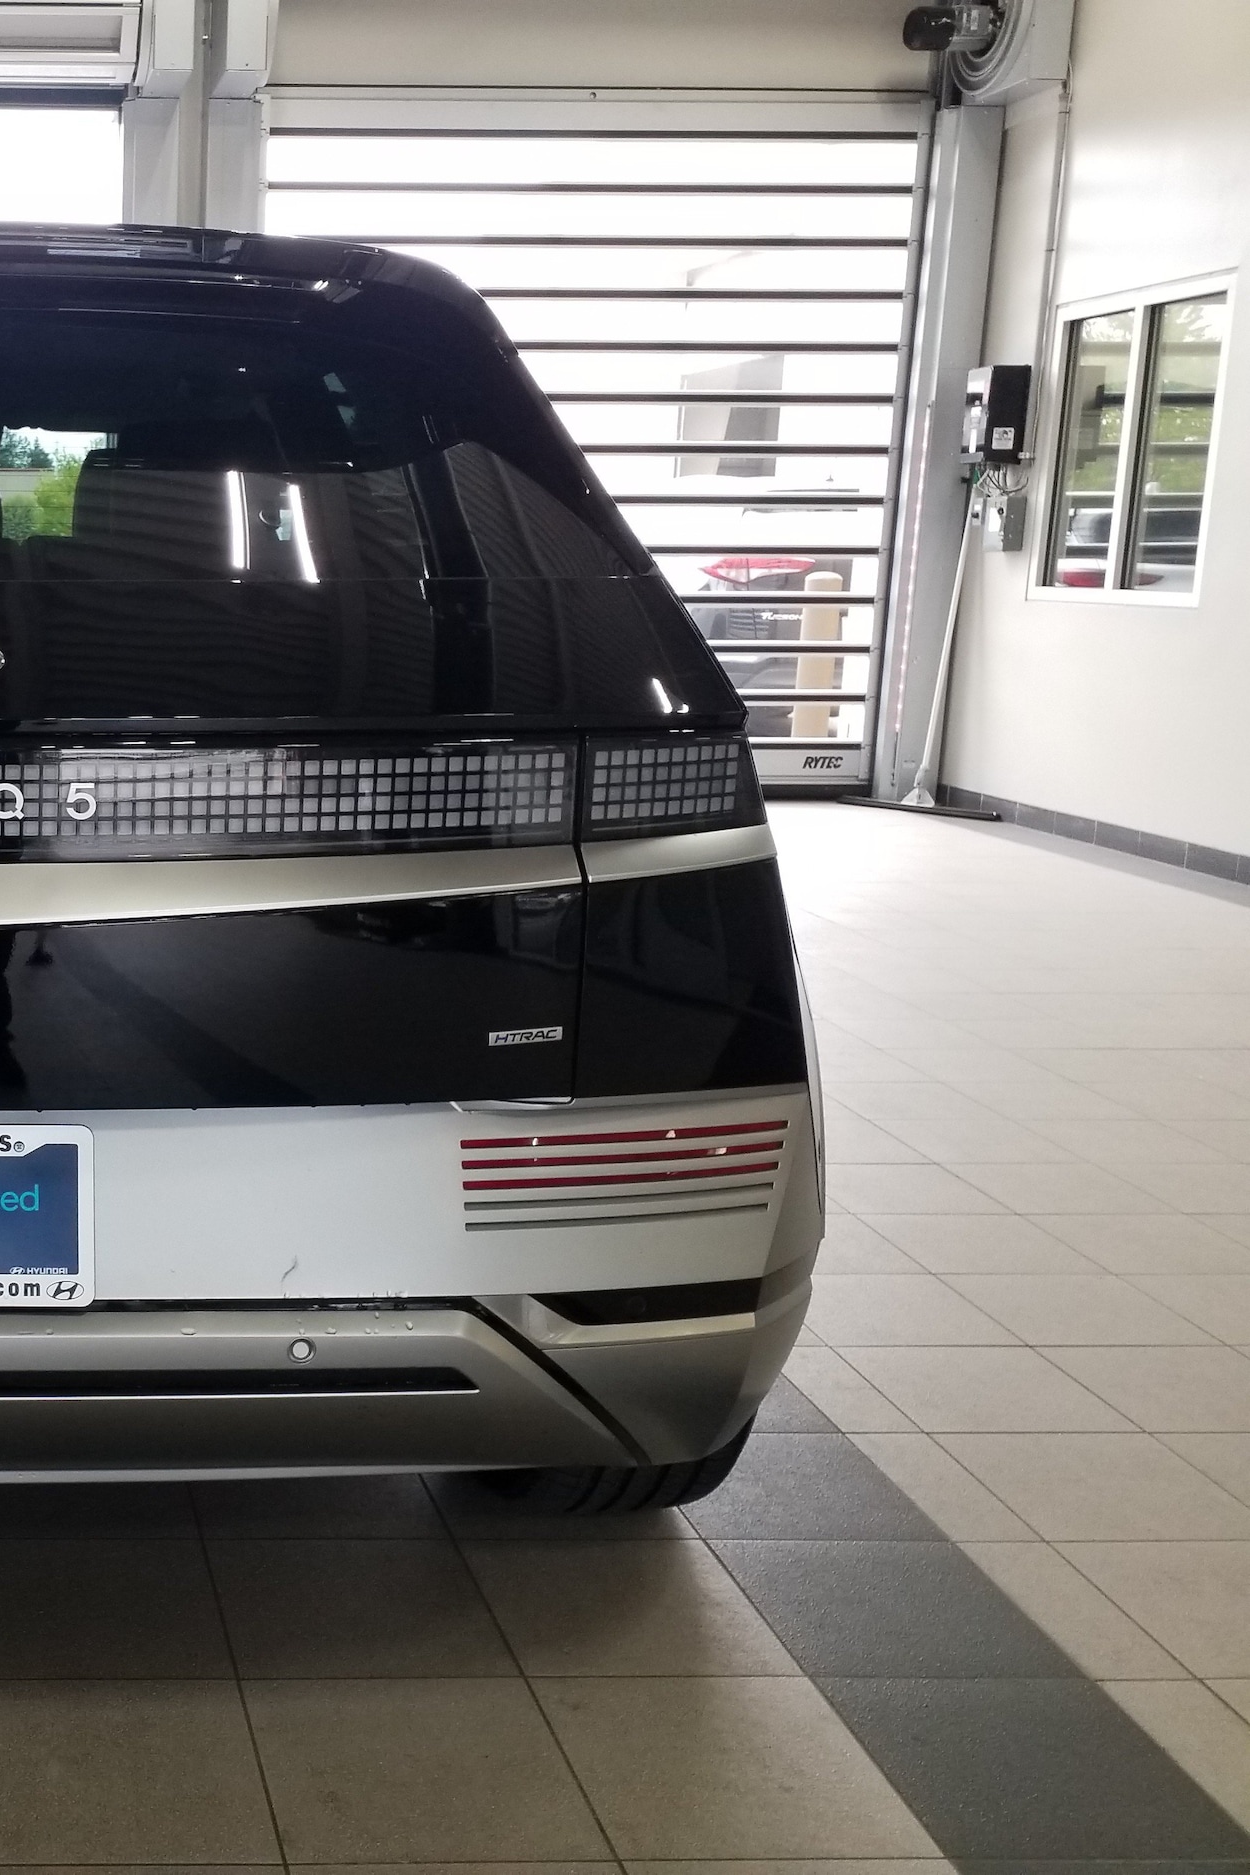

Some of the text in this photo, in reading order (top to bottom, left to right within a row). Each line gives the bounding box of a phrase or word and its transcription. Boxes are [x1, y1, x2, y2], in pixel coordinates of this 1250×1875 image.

[802, 755, 844, 769] RYTEC
[65, 782, 96, 820] 5
[495, 1029, 558, 1043] HTRAC
[27, 1267, 69, 1275] HYUNDAI
